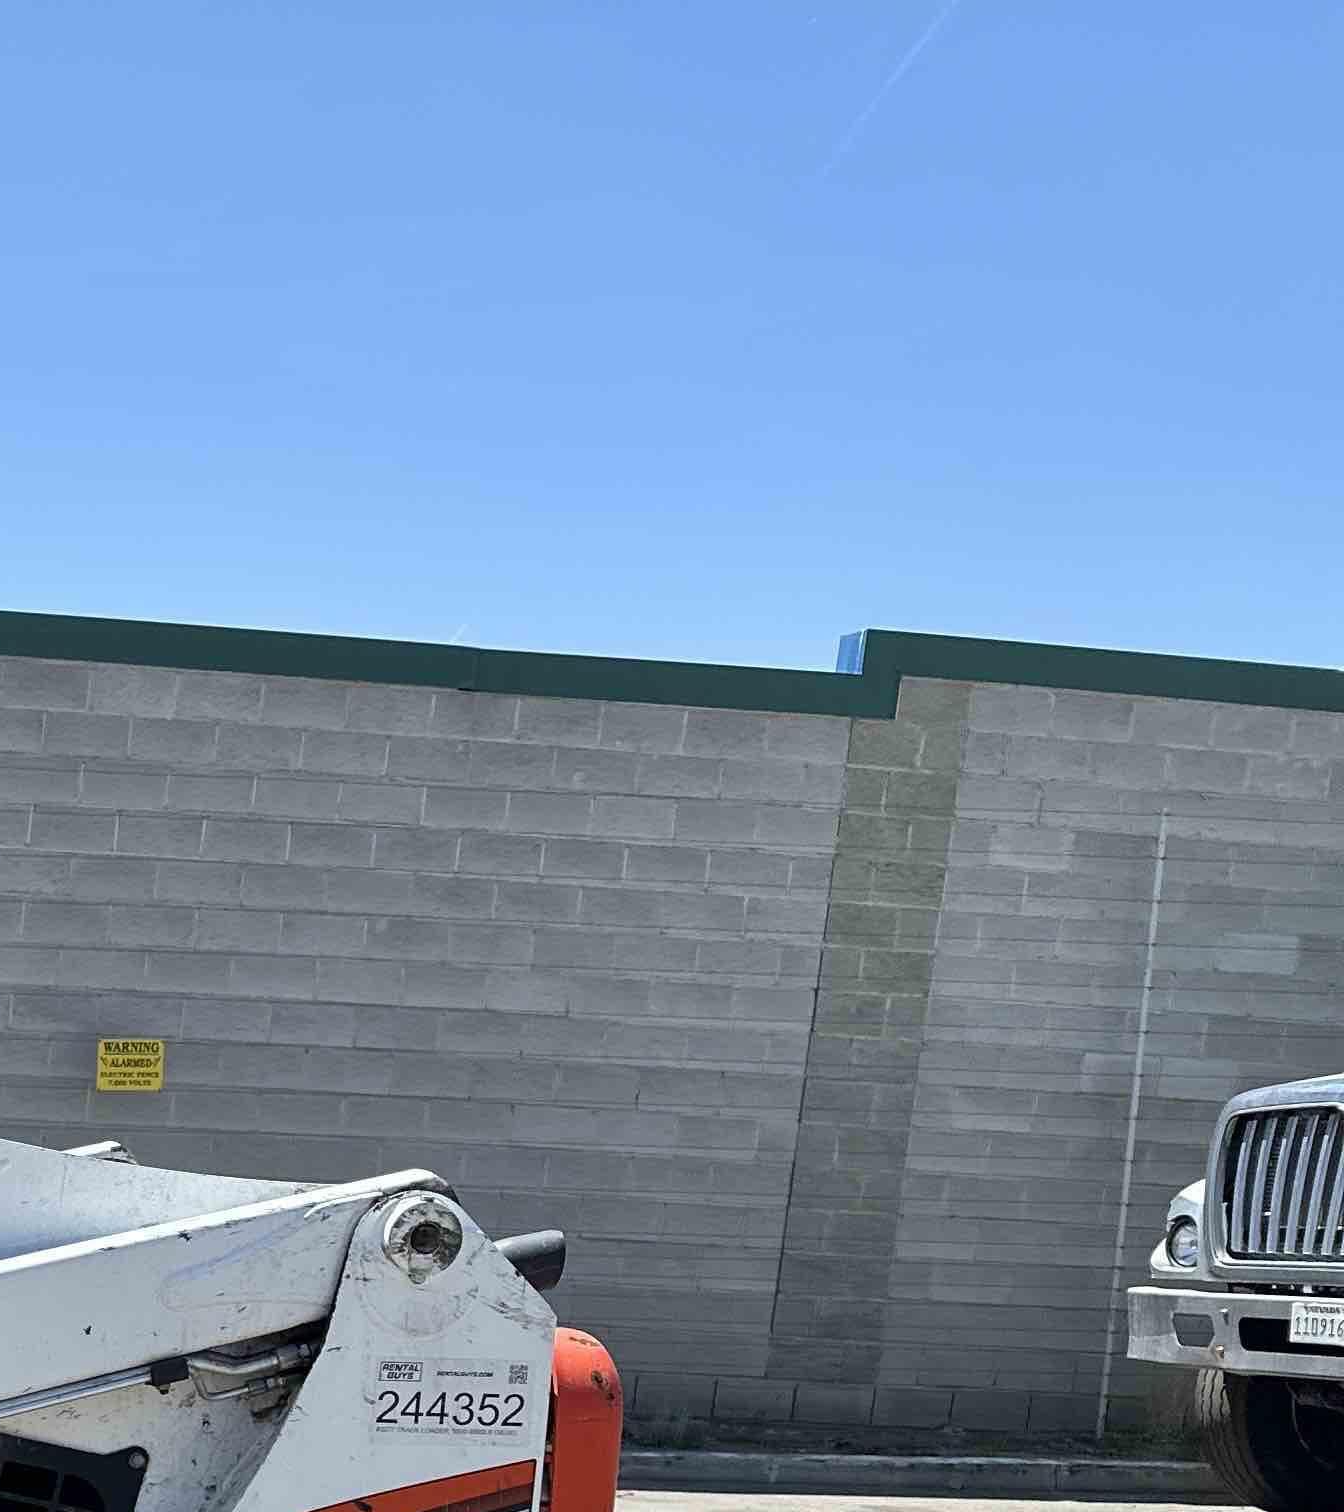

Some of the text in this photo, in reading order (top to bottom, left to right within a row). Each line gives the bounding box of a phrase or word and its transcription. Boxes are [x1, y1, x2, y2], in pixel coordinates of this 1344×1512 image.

[103, 1041, 160, 1053] WARNING
[110, 1057, 152, 1068] ALARMED
[382, 1363, 420, 1372] RENTAL
[375, 1390, 526, 1427] 244352
